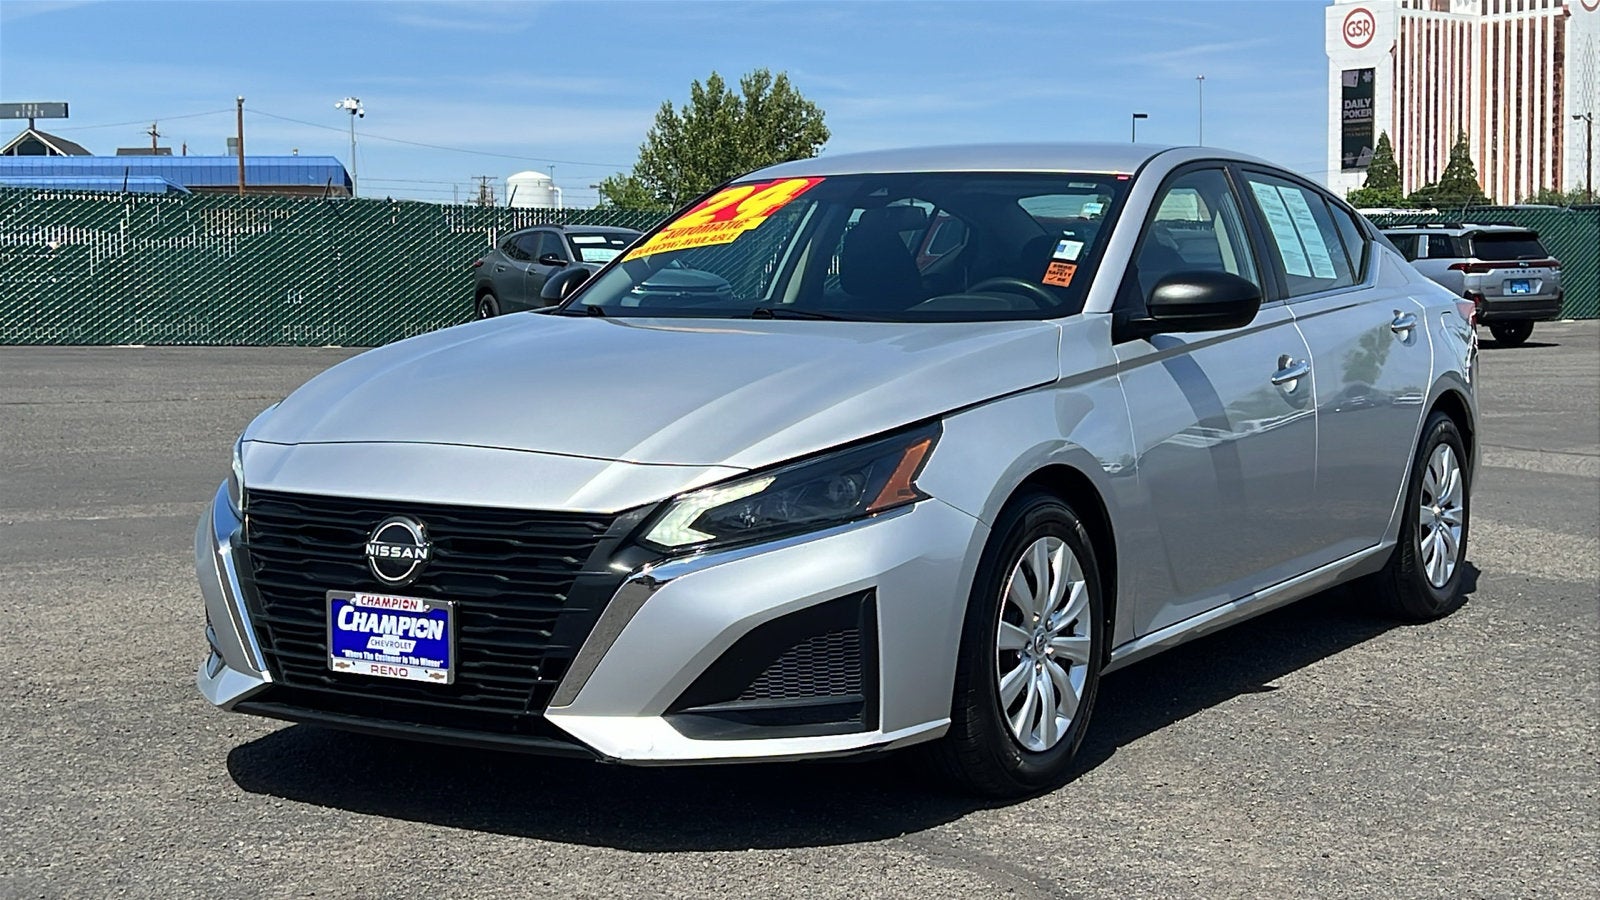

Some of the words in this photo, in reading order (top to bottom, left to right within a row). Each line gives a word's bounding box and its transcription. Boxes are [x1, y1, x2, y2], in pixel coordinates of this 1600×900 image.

[1346, 19, 1370, 37] GSR
[1344, 98, 1371, 109] DAILY
[1343, 108, 1372, 119] POKER
[660, 218, 749, 242] AUTOMATIC
[678, 231, 738, 249] AVAILABLE
[365, 543, 428, 560] NISSAN
[360, 595, 419, 610] CHAMPION
[337, 605, 444, 640] CHAMPION
[370, 639, 412, 650] CHEVROLET
[363, 651, 374, 661] The
[409, 656, 420, 666] The
[370, 664, 409, 678] RENO
